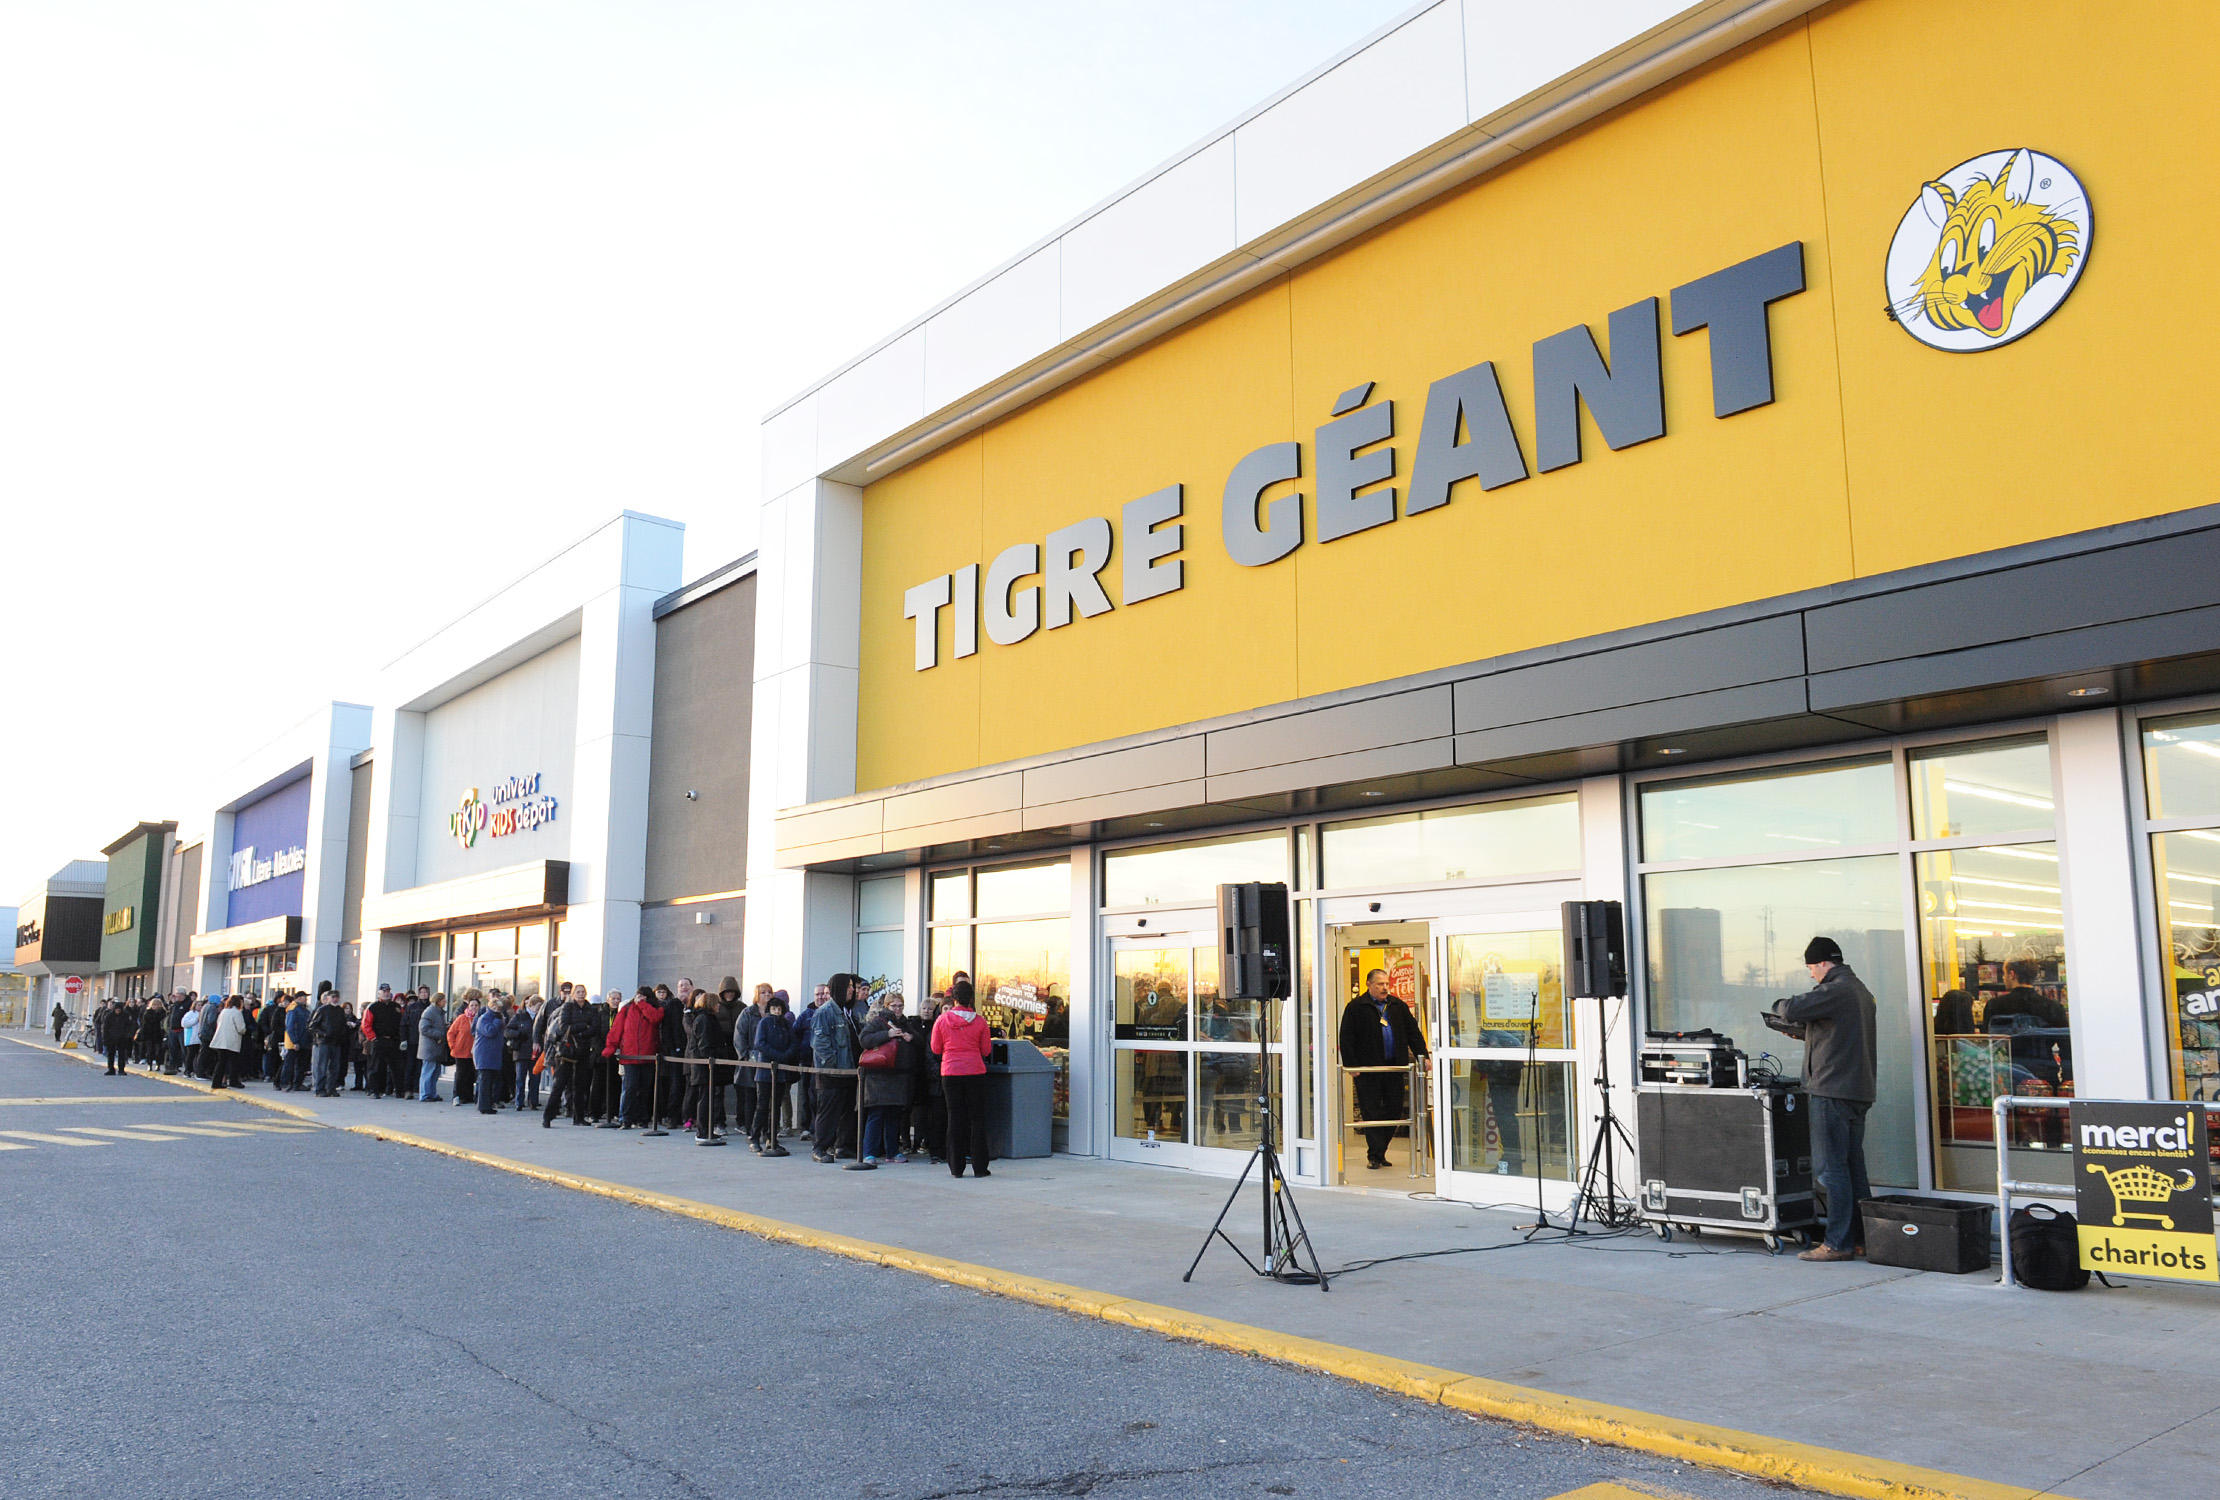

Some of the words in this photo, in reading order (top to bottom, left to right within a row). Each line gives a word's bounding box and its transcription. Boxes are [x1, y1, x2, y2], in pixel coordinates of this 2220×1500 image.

[903, 483, 1185, 673] TIGRE
[1221, 239, 1807, 568] GÉANT
[491, 772, 541, 806] univers
[489, 807, 517, 838] KIDS
[514, 794, 559, 832] dépôt
[994, 987, 1048, 1015] économies
[1482, 1019, 1505, 1028] heures
[2080, 1111, 2195, 1157] merci!
[2082, 1146, 2128, 1157] économisez
[2128, 1150, 2157, 1158] encore
[2157, 1149, 2188, 1159] bientôt
[2089, 1237, 2207, 1271] chariots
